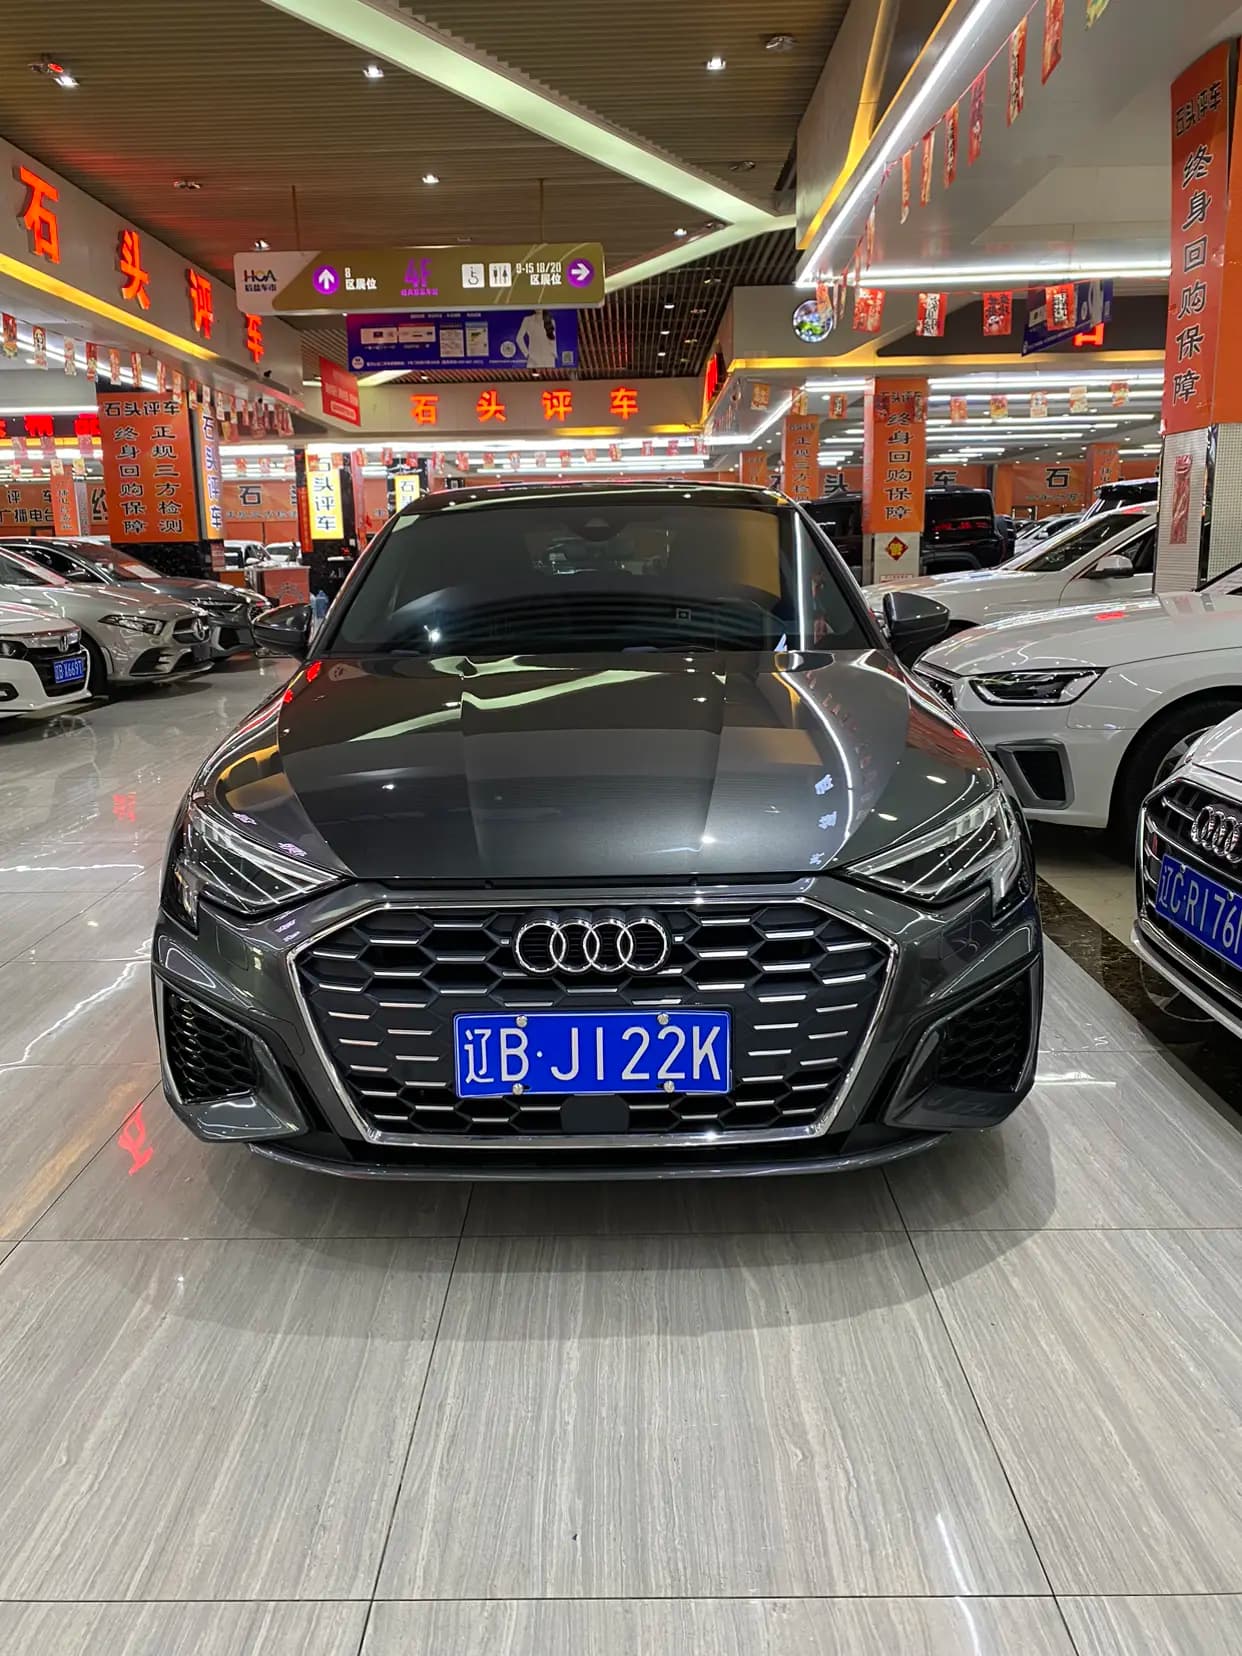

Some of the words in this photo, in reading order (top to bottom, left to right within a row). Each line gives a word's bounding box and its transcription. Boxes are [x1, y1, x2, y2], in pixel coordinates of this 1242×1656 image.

[403, 256, 433, 288] 4F
[1173, 144, 1213, 405] 终身回购保障
[105, 401, 181, 417] 石头评车
[408, 387, 640, 425] 石头评车
[114, 426, 149, 534] 终身回购保障
[151, 425, 193, 533] 正规三方检测
[202, 414, 223, 530] 石头评车
[239, 484, 262, 505] 石
[887, 411, 914, 521] 终身回购保障
[1047, 468, 1071, 488] 石
